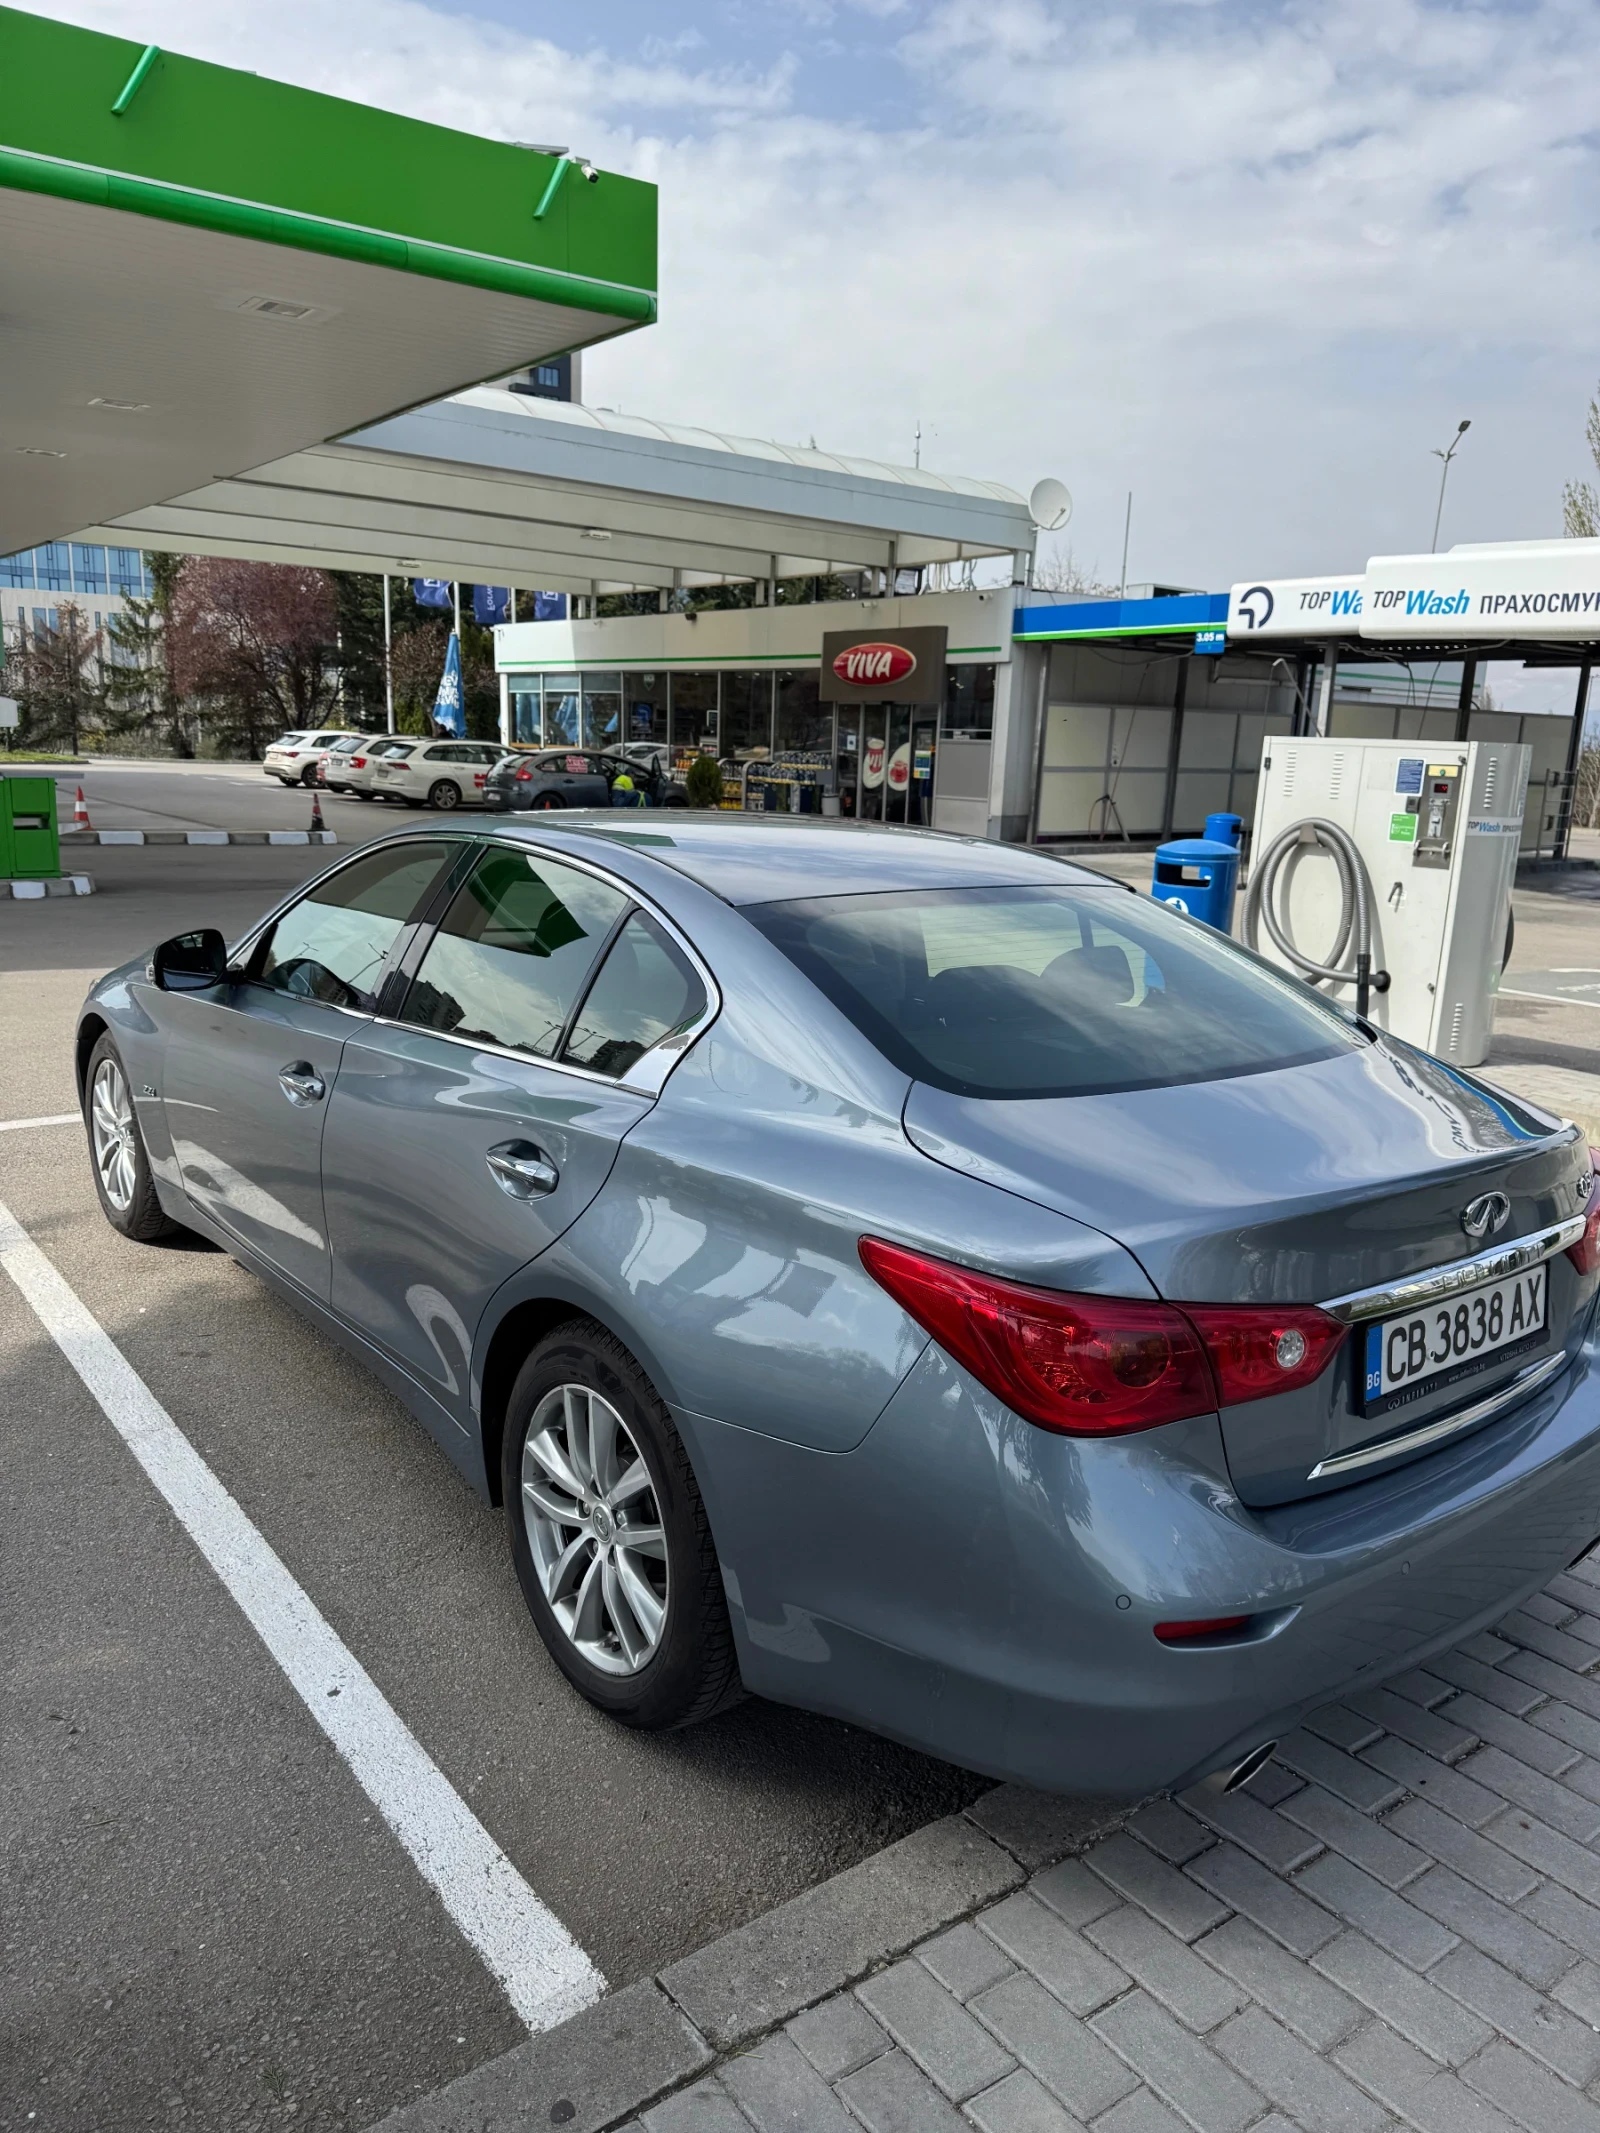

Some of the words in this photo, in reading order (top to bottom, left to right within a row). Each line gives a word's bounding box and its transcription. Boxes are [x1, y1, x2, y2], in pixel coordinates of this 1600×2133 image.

[1196, 632, 1213, 642] 3.05
[847, 651, 893, 679] VIVA
[1387, 1319, 1426, 1383] CB
[1433, 1291, 1503, 1364] 3838
[1509, 1274, 1541, 1335] AX
[1366, 1370, 1380, 1390] BG
[1401, 1382, 1438, 1404] INFINITI
